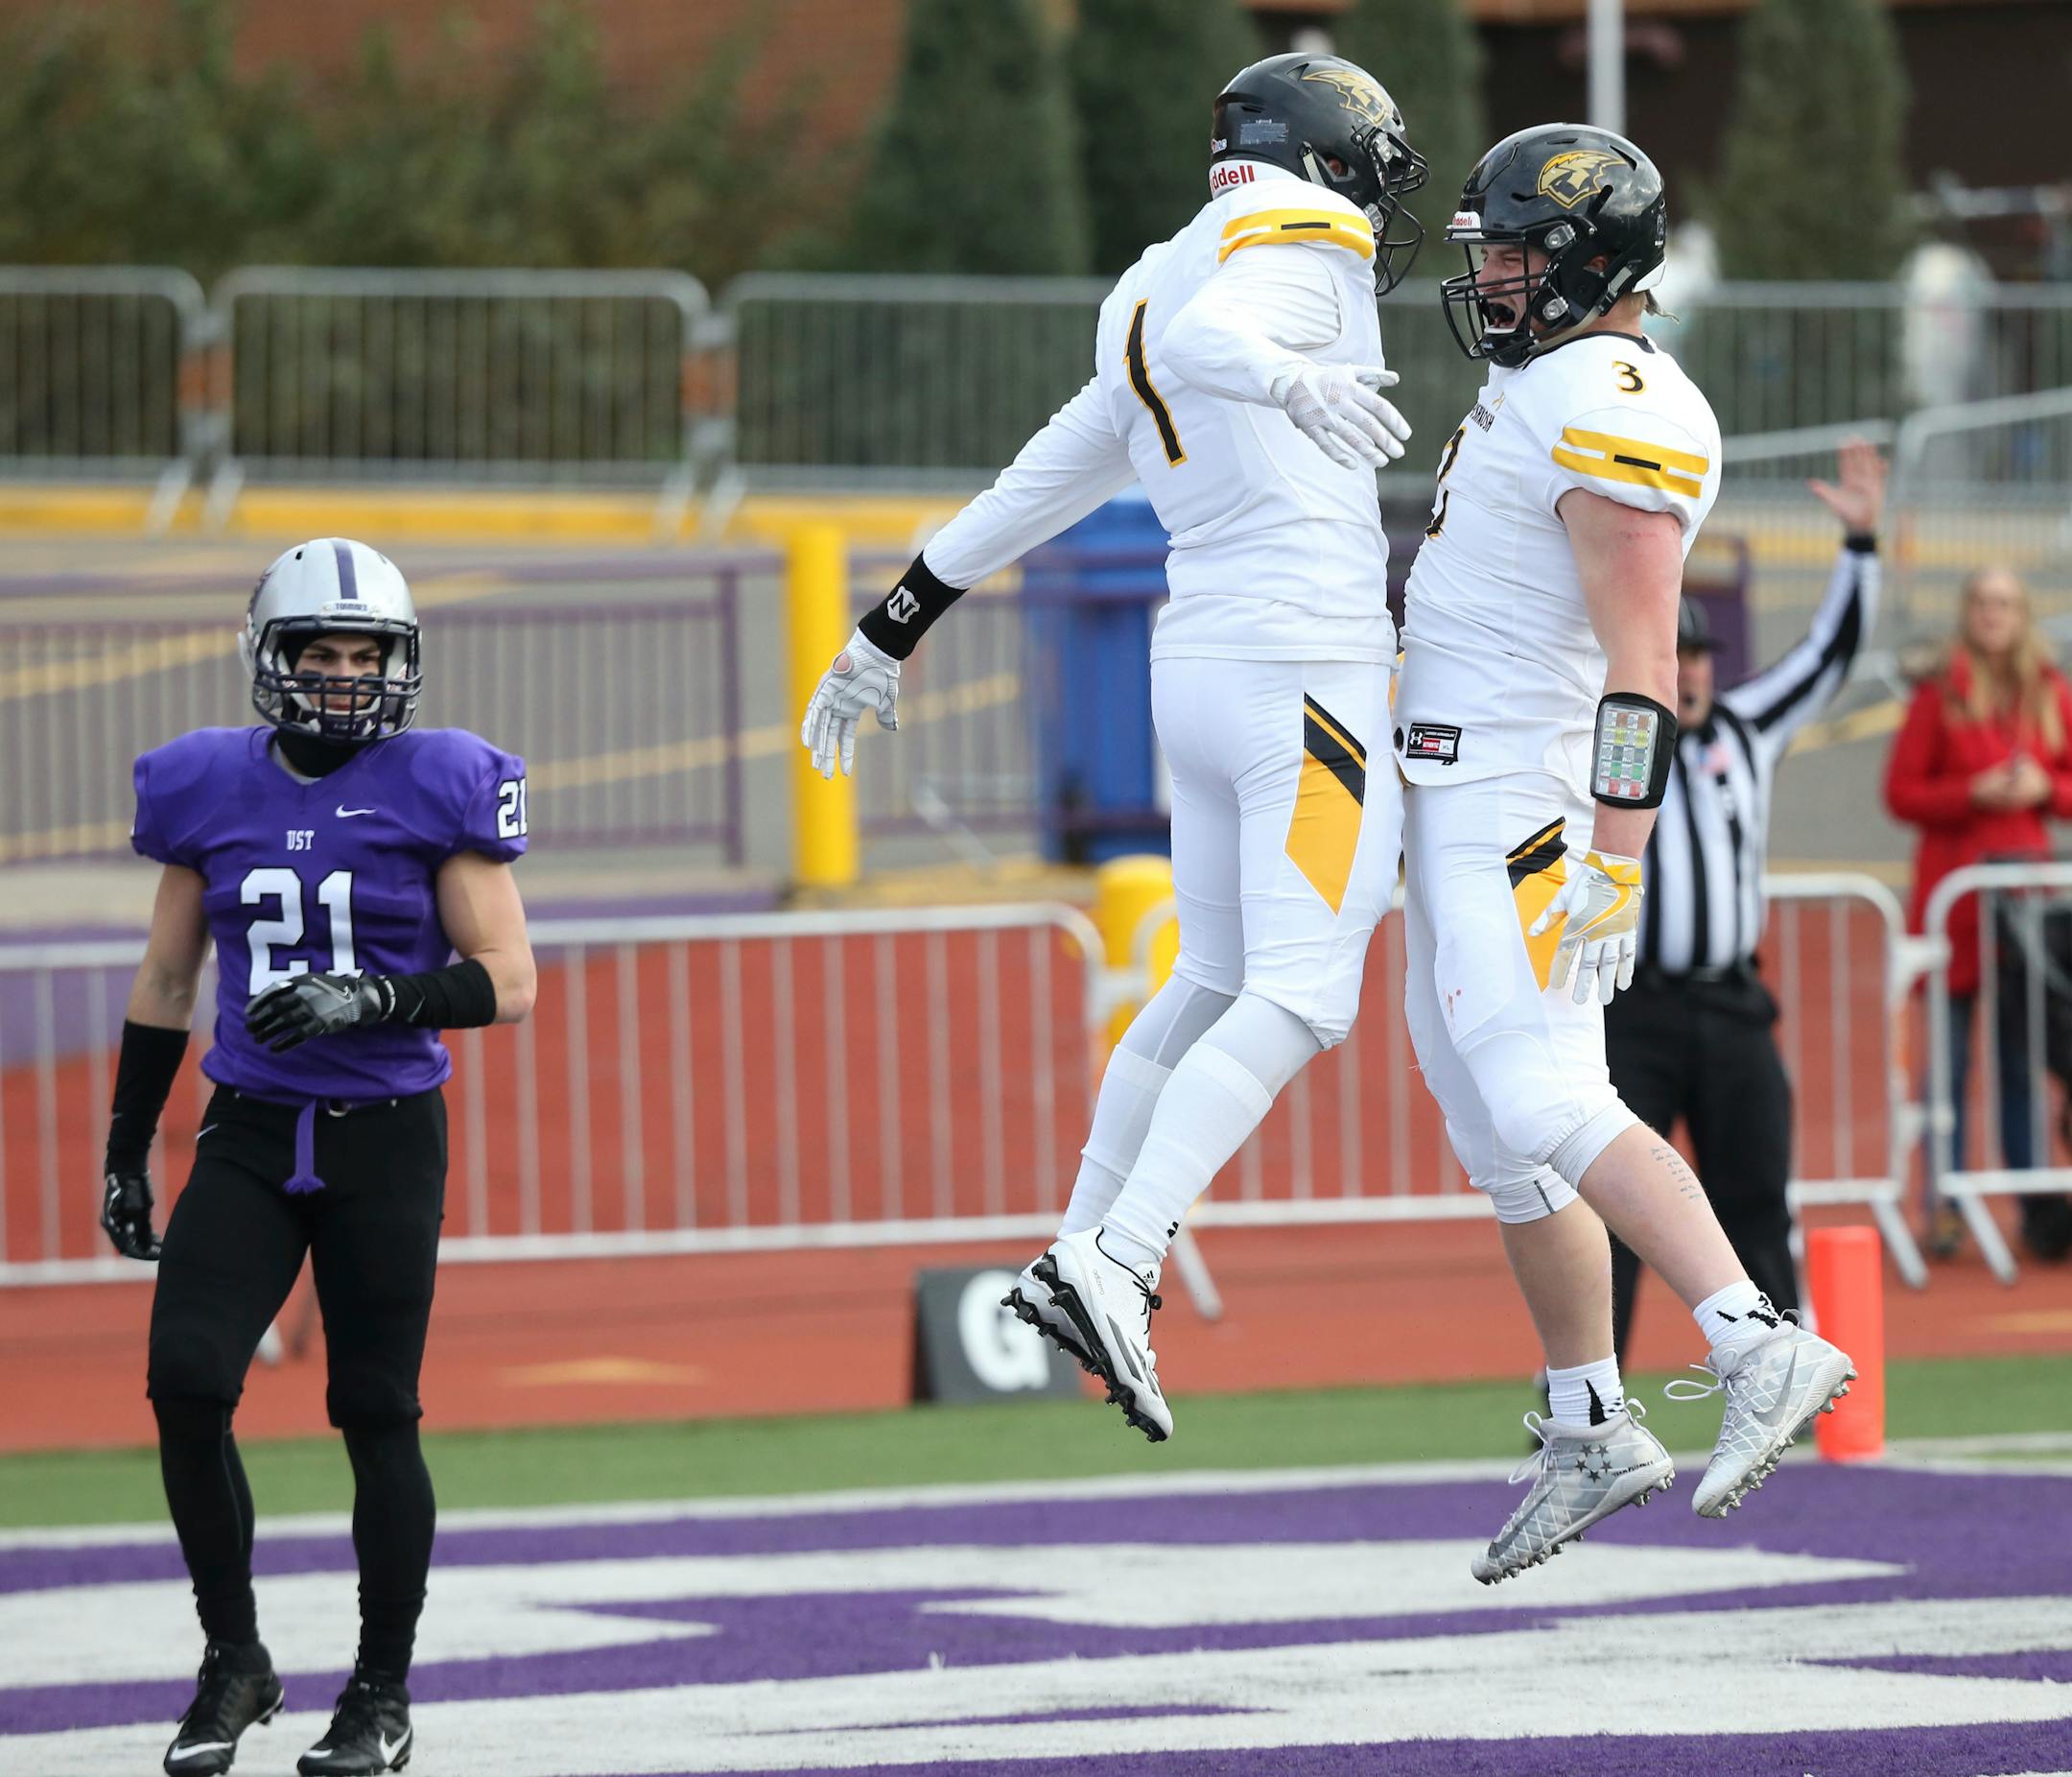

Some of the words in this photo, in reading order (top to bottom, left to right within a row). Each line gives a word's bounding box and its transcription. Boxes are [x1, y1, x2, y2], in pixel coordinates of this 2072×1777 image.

[1211, 165, 1255, 191] ddell
[1123, 297, 1189, 469] 1
[1612, 360, 1646, 395] 3
[287, 829, 315, 851] UST
[497, 777, 528, 841] 21
[241, 867, 364, 996] 21
[958, 1269, 1051, 1392] G
